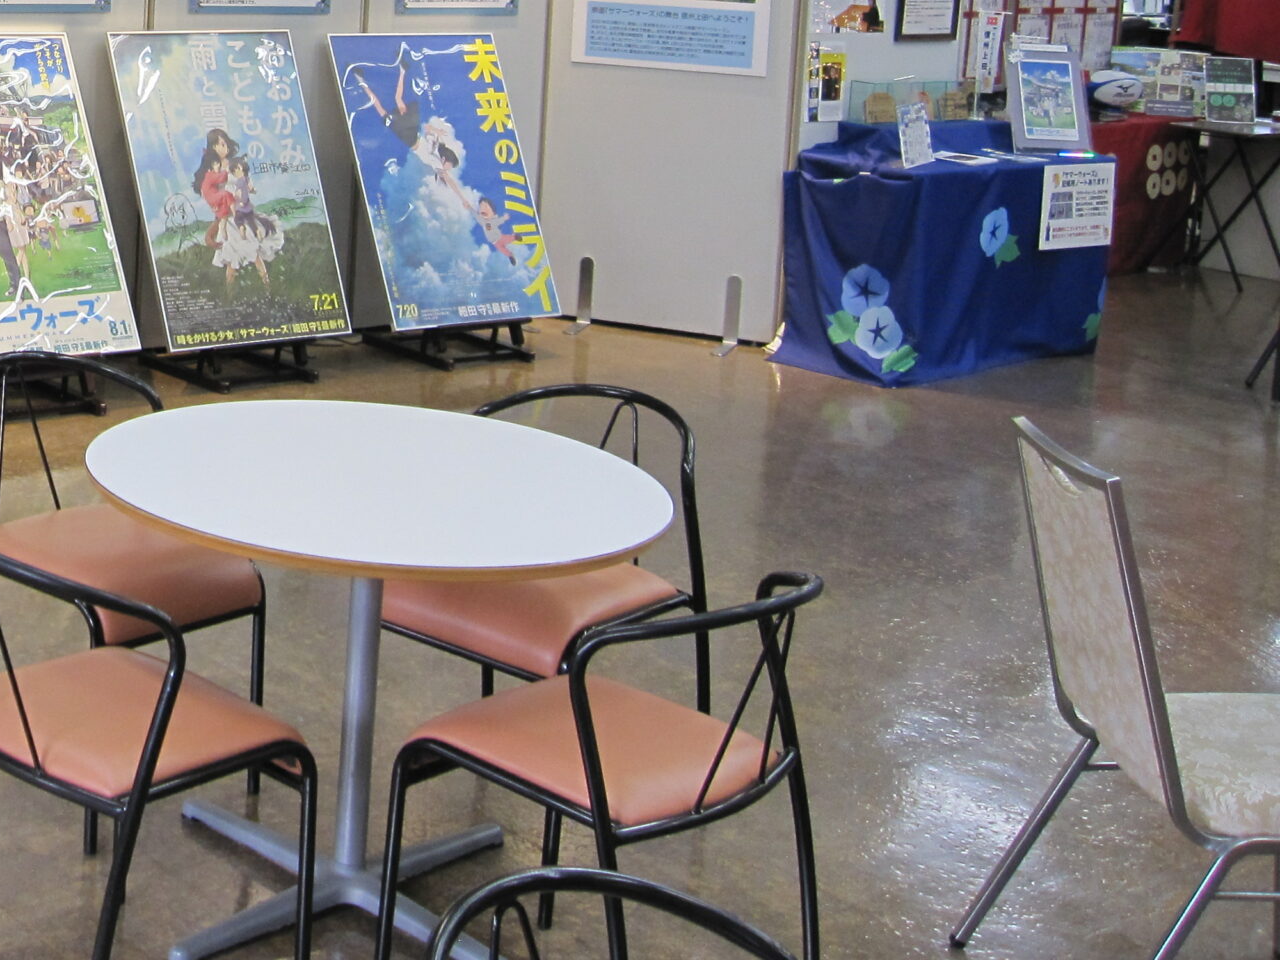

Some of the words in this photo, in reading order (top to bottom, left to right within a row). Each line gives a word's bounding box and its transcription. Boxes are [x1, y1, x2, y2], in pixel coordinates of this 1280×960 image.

[226, 40, 265, 159] こどもの
[463, 38, 552, 313] 未来のミライ
[310, 292, 340, 312] 7.21
